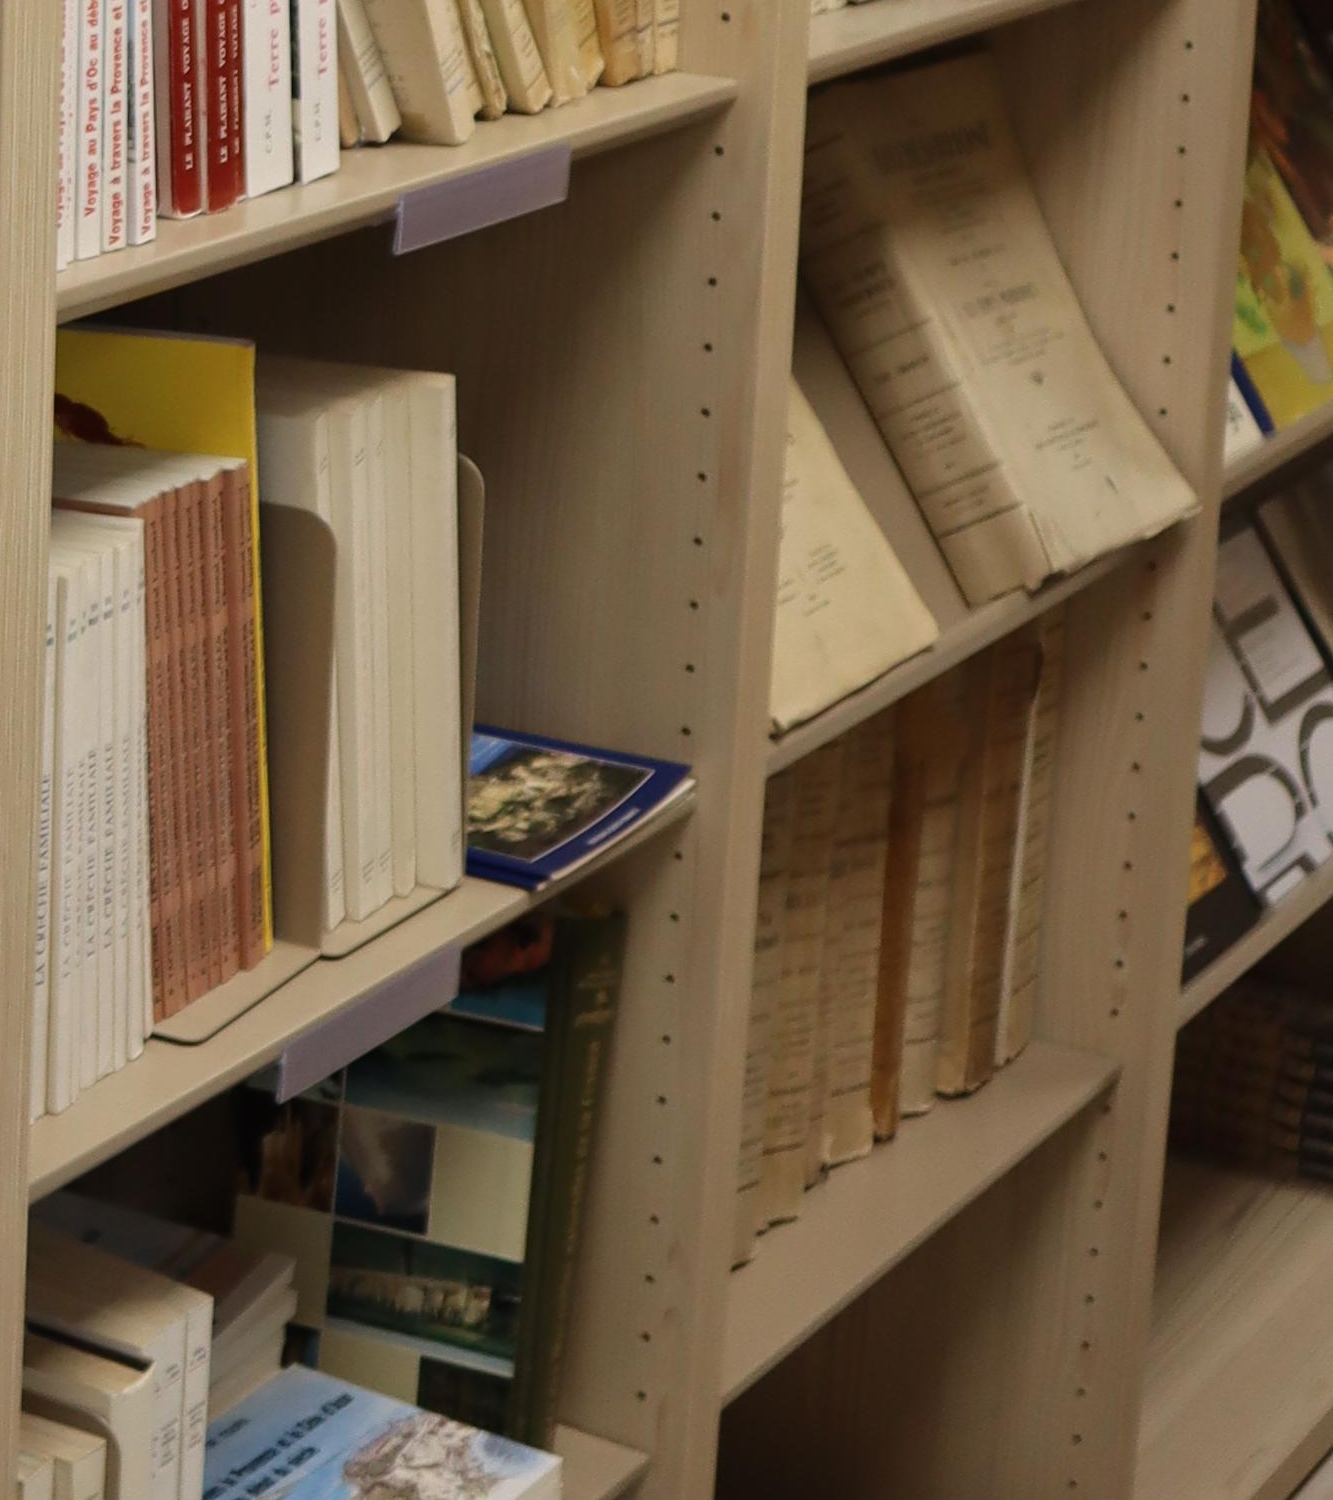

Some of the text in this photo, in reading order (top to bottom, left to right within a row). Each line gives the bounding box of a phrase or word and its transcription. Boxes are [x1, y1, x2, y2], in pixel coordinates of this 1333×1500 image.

[87, 33, 100, 50] au
[181, 18, 191, 73] VOYAGE
[86, 57, 99, 90] d'Oc
[266, 28, 280, 91] Terre
[84, 97, 100, 132] Pays
[86, 138, 99, 156] au
[184, 151, 193, 170] LE
[84, 162, 100, 217] Voyage
